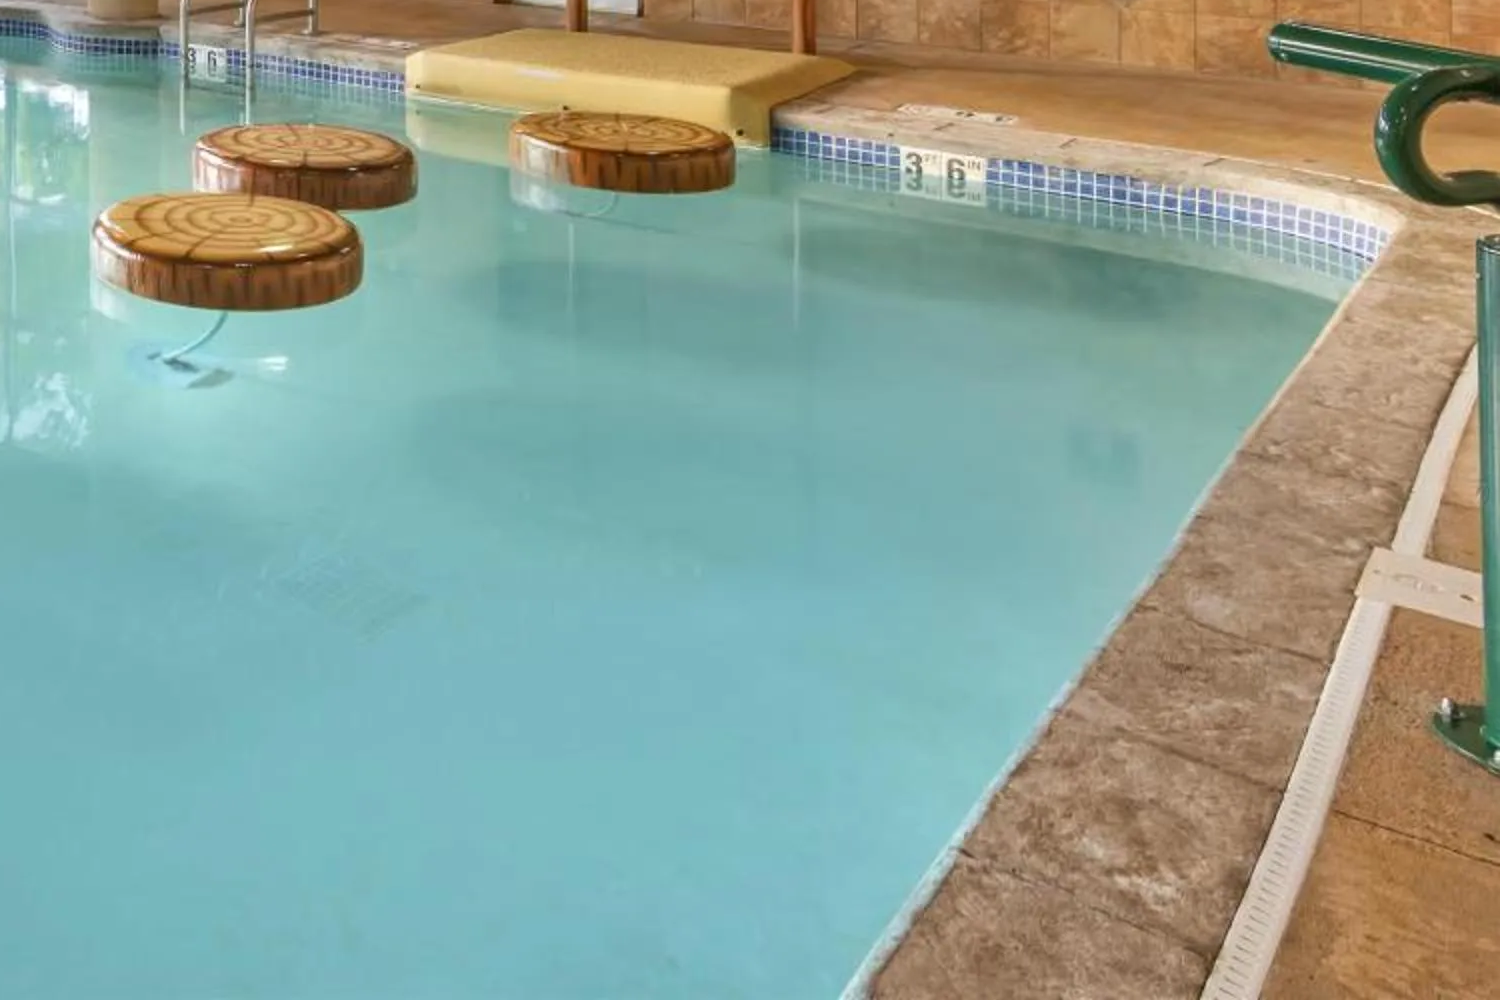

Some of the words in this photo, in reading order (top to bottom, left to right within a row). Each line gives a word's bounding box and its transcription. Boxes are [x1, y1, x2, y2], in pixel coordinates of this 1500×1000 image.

[905, 151, 923, 175] 3
[946, 158, 965, 181] 6
[967, 159, 981, 172] IN
